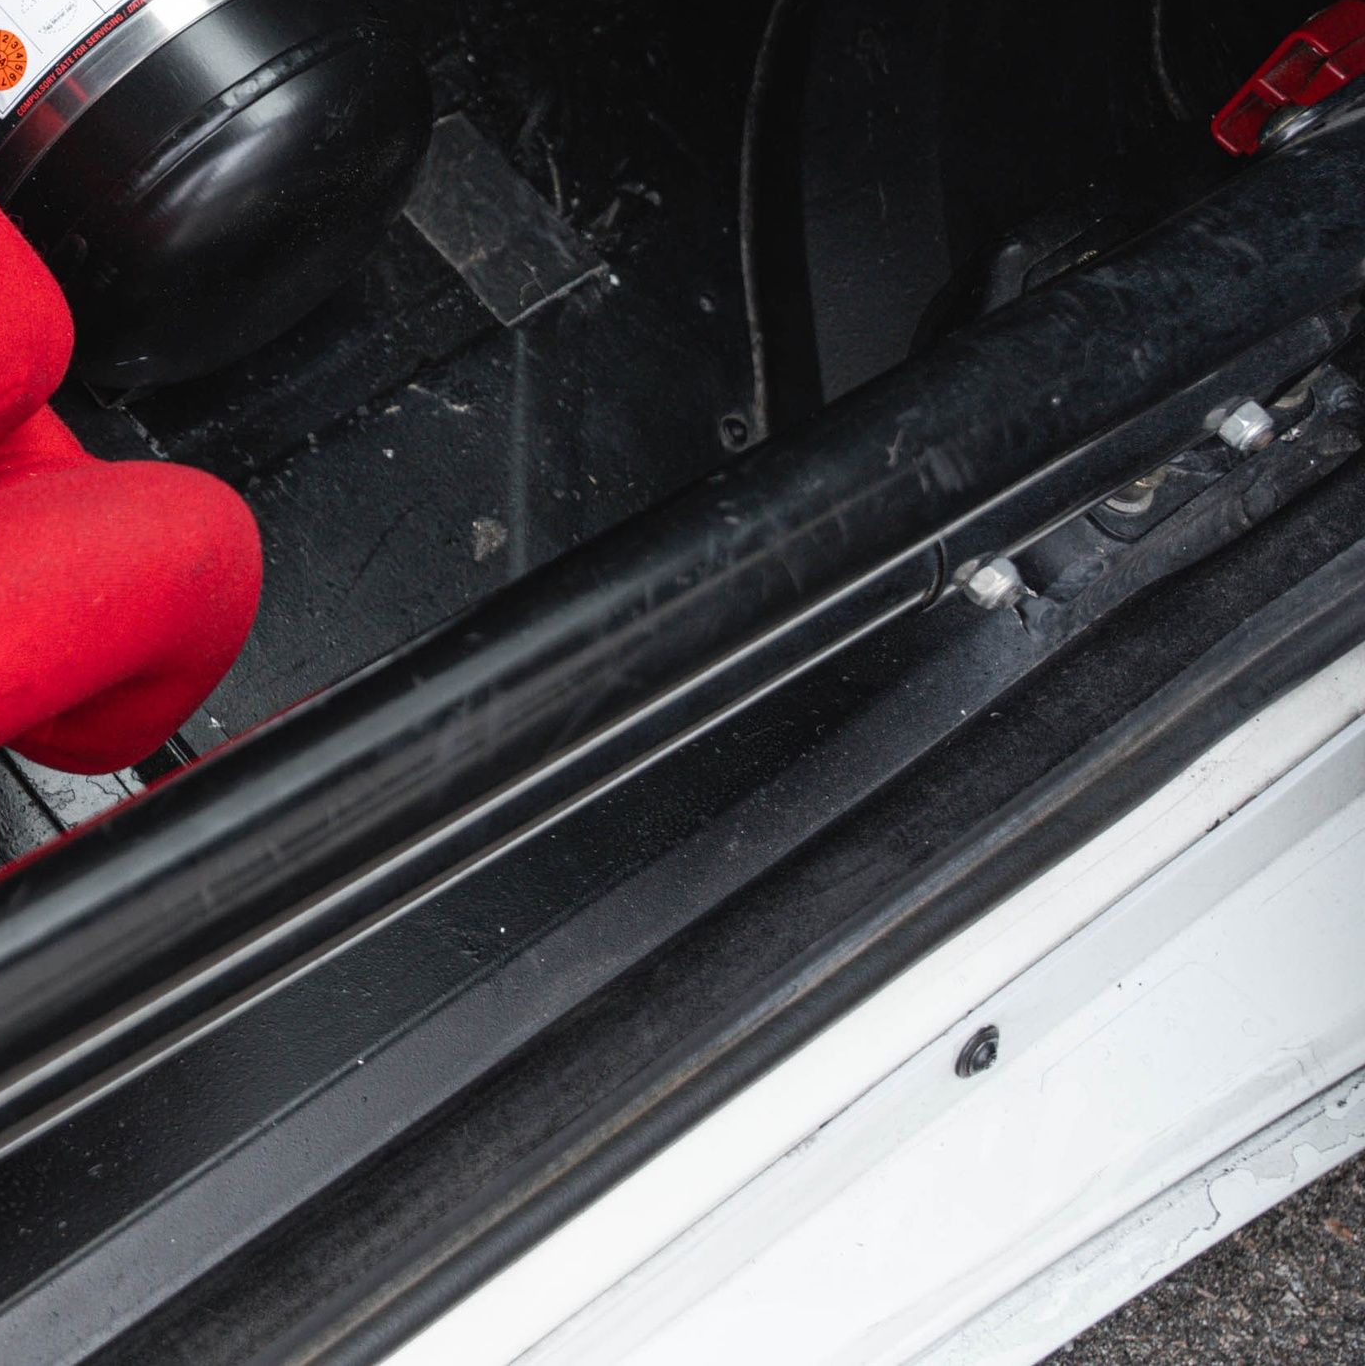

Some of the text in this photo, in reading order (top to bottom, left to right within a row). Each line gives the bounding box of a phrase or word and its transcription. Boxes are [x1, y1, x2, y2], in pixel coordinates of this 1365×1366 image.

[2, 35, 9, 43] 2
[11, 41, 18, 49] 3
[16, 71, 57, 116] COMPULSORY
[54, 54, 74, 75] DATE
[71, 43, 87, 59] FOR
[85, 12, 123, 47] SERVICING
[10, 73, 16, 81] 6
[2, 77, 7, 86] 7
